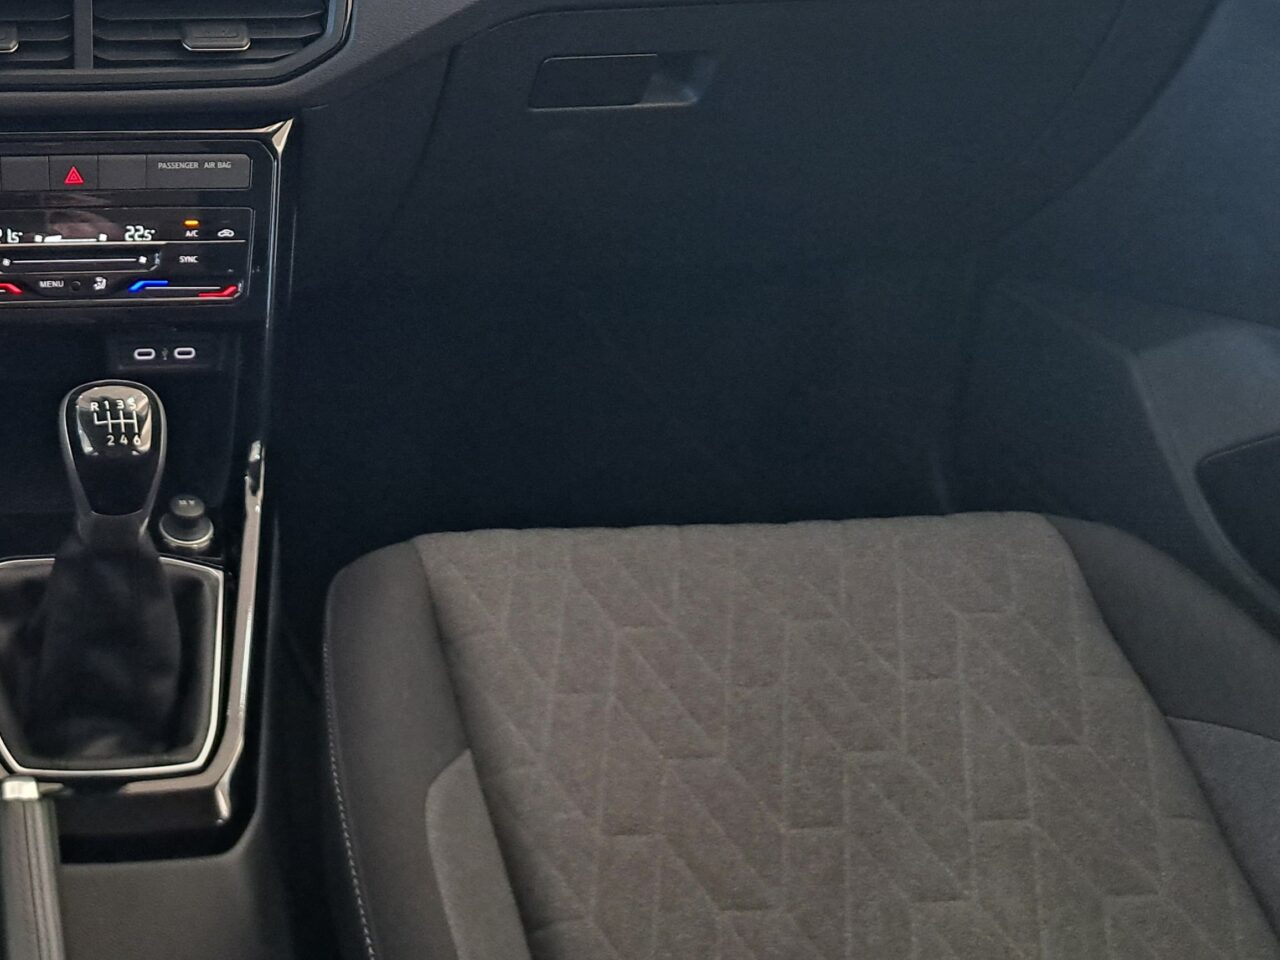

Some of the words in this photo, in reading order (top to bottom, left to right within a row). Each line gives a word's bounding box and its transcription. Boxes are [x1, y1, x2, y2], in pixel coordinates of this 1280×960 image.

[158, 161, 199, 169] PASSENGER
[204, 161, 216, 169] AIR
[217, 161, 232, 169] BAG
[185, 230, 199, 238] A/C
[179, 255, 199, 263] SYNC
[39, 280, 64, 288] MENU
[90, 402, 99, 411] R
[103, 400, 110, 410] 1
[116, 399, 125, 409] 3
[107, 435, 115, 446] 2
[120, 435, 128, 445] 4
[133, 434, 141, 445] 6
